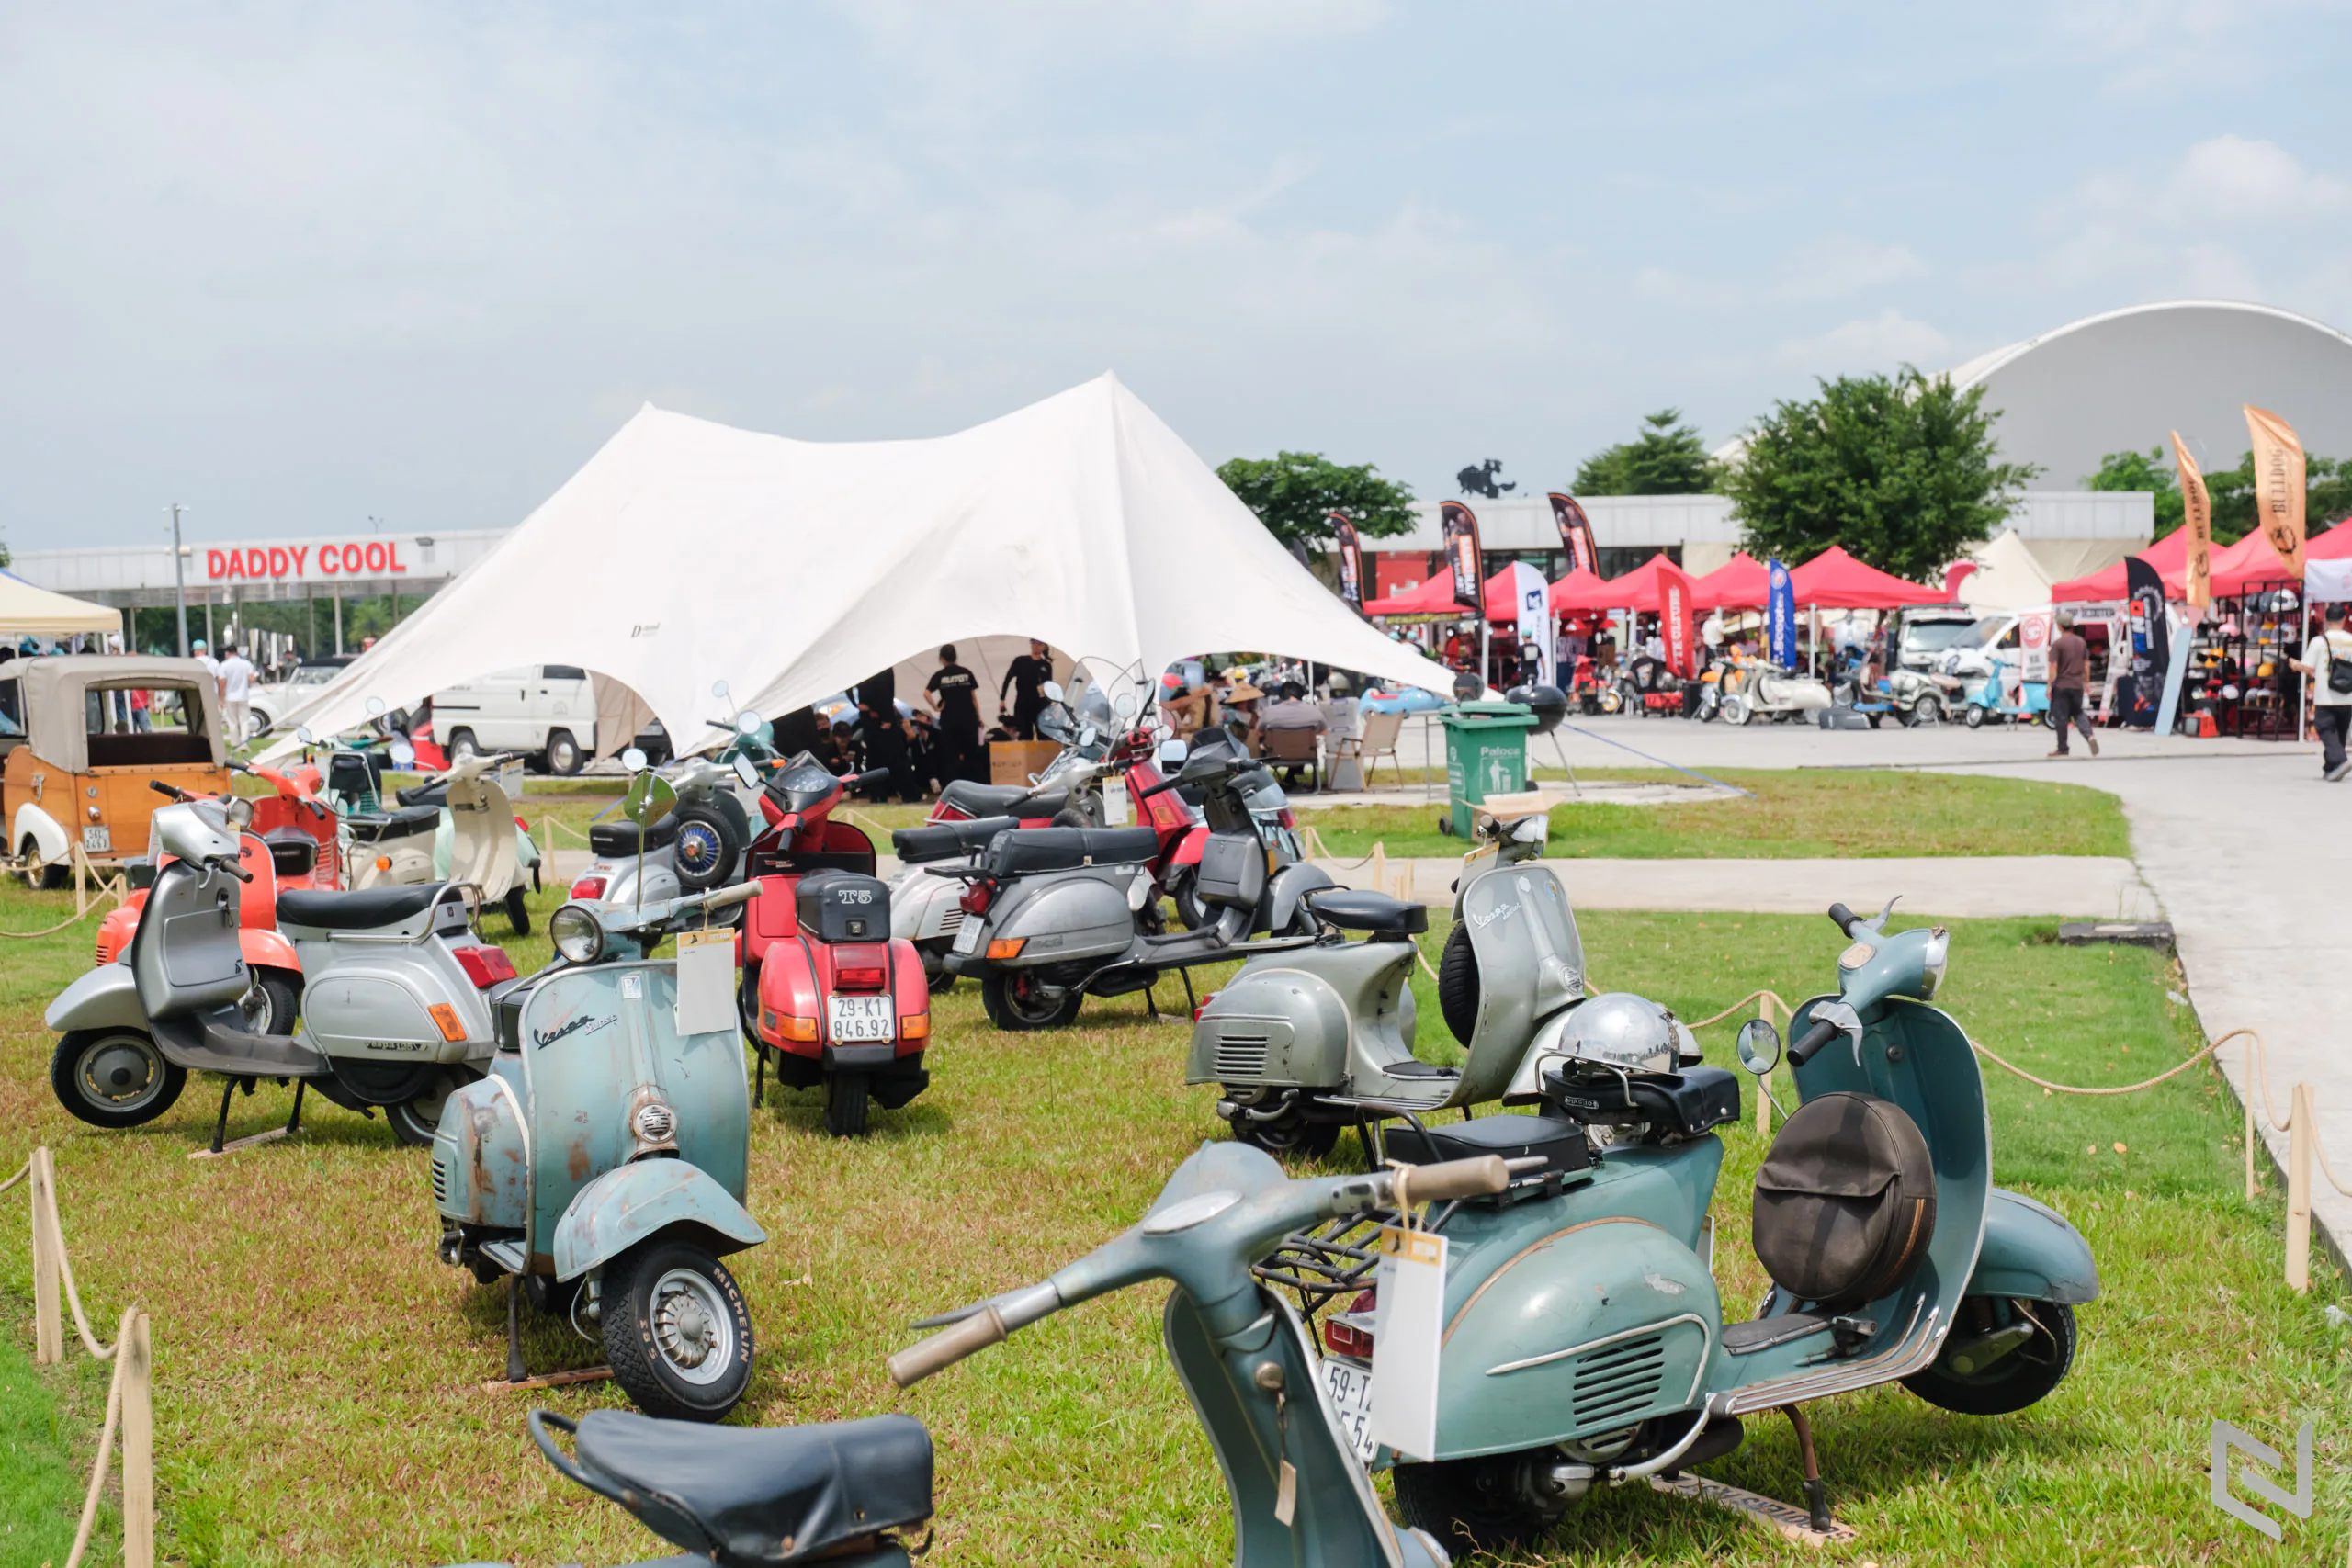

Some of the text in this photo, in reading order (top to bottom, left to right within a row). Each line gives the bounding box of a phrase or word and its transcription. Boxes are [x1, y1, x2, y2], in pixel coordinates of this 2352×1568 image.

[2269, 448, 2287, 514] BULLDOG
[207, 542, 406, 579] DADDY COOL
[837, 889, 873, 905] T5
[838, 998, 882, 1018] 29-K1
[533, 1014, 596, 1051] Vespa
[833, 1018, 890, 1039] 846.92
[713, 1267, 751, 1363] MICHELIN
[1329, 1366, 1372, 1412] 59-T
